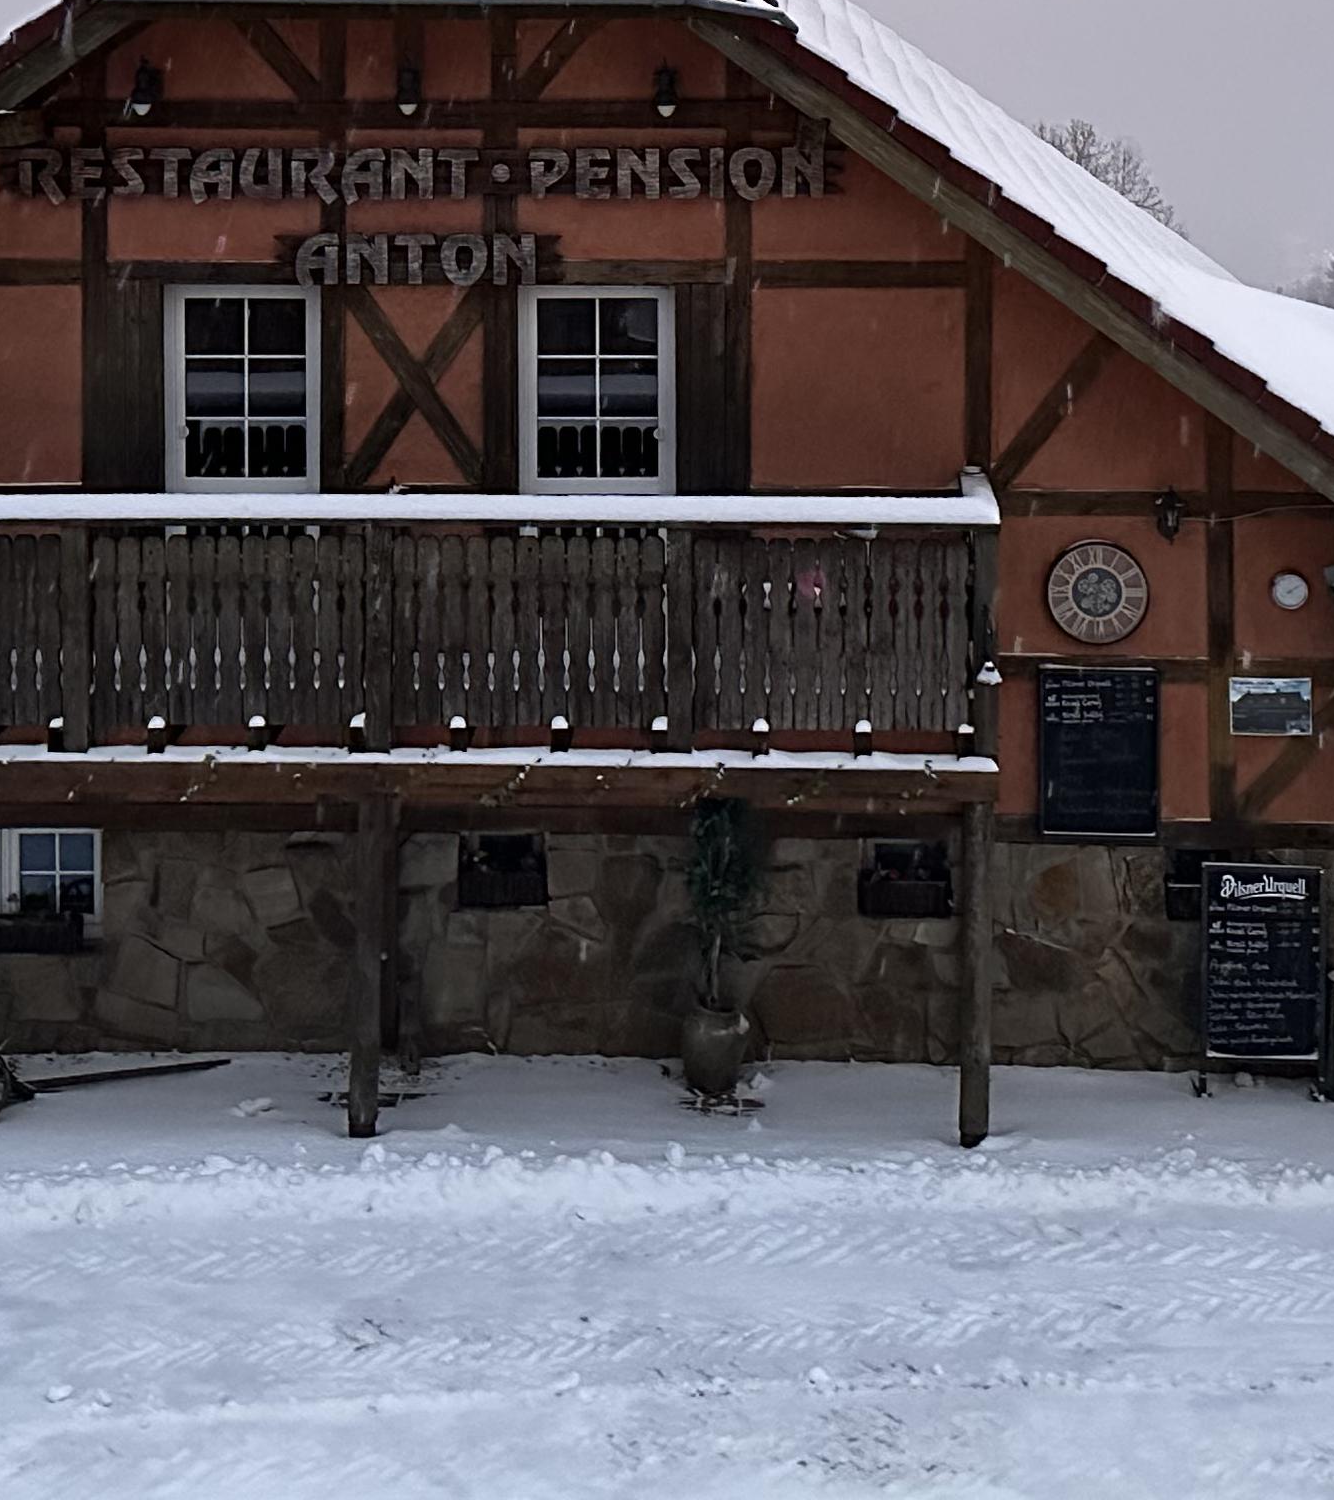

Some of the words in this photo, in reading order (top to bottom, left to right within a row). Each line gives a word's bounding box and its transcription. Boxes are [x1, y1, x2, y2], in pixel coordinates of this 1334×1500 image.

[18, 148, 479, 205] RESTAURANT
[528, 147, 824, 201] PENSION
[295, 233, 536, 288] ANTON
[1087, 546, 1103, 566] XII
[1220, 874, 1264, 898] Pilsner
[1263, 874, 1306, 899] Urquell
